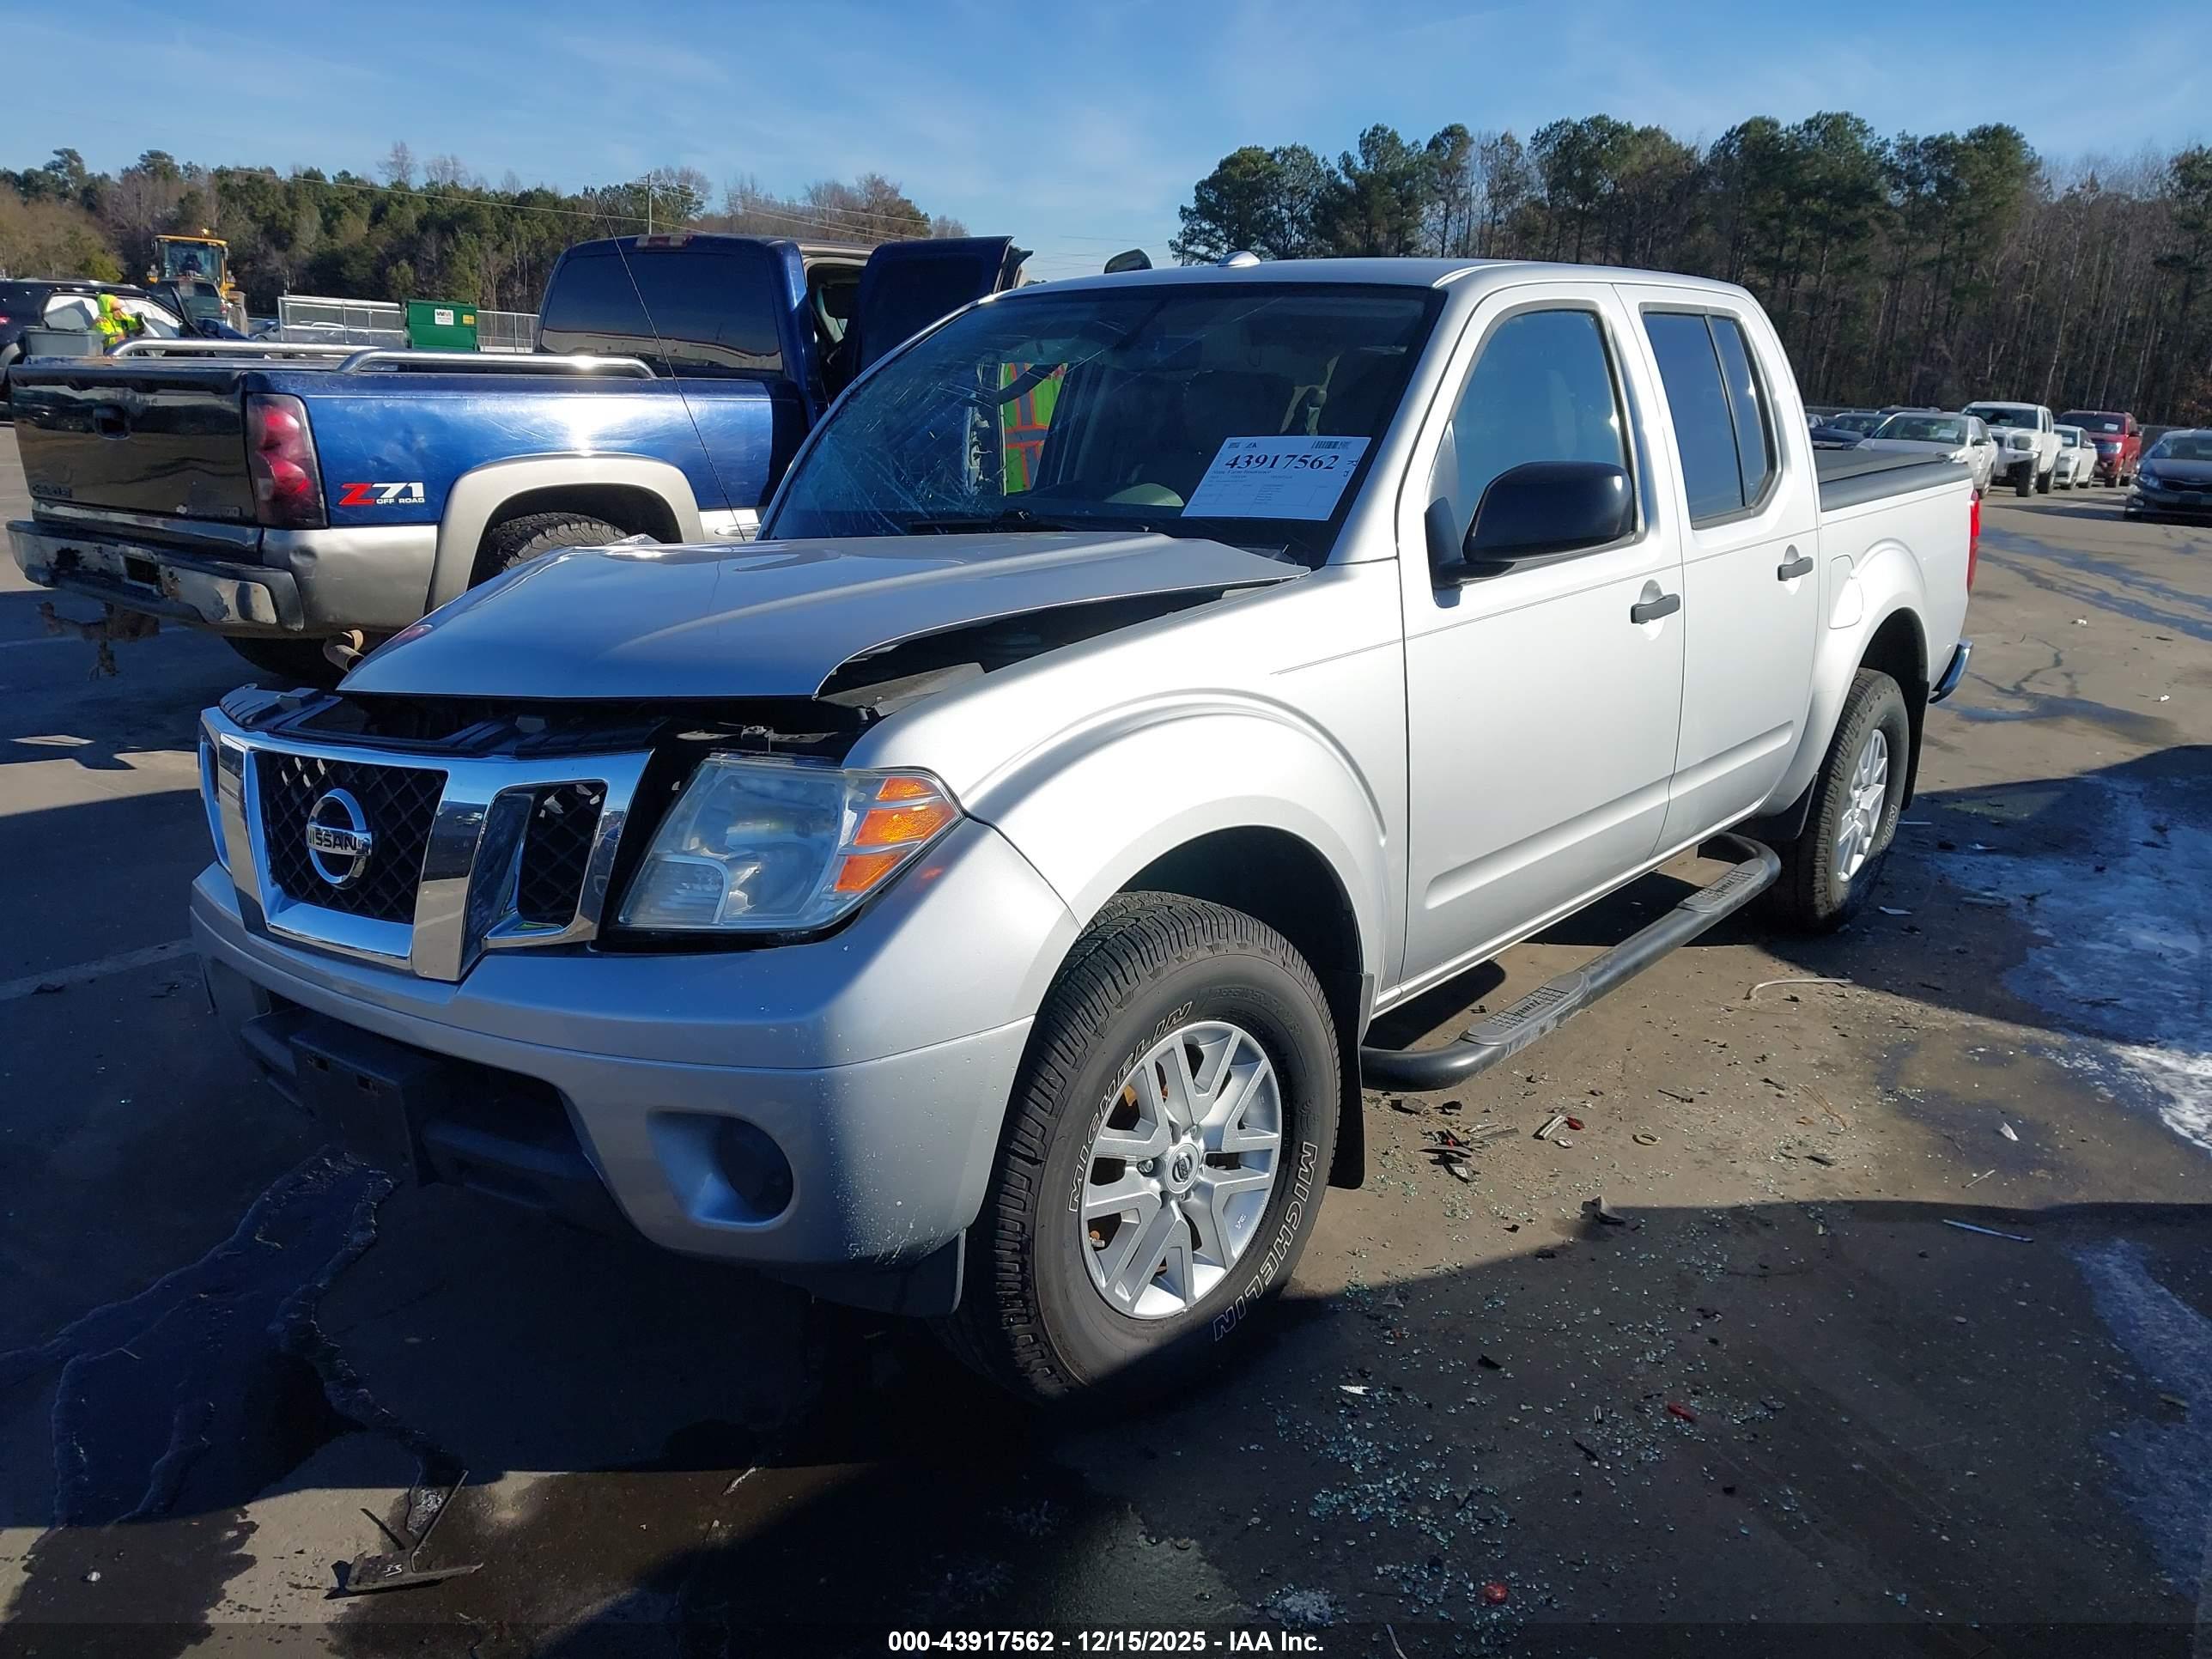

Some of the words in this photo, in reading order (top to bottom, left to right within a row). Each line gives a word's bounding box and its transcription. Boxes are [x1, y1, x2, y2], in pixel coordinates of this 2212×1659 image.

[1225, 454, 1340, 469] 43917562
[338, 483, 424, 505] Z71
[1212, 1140, 1319, 1342] MICHELIN
